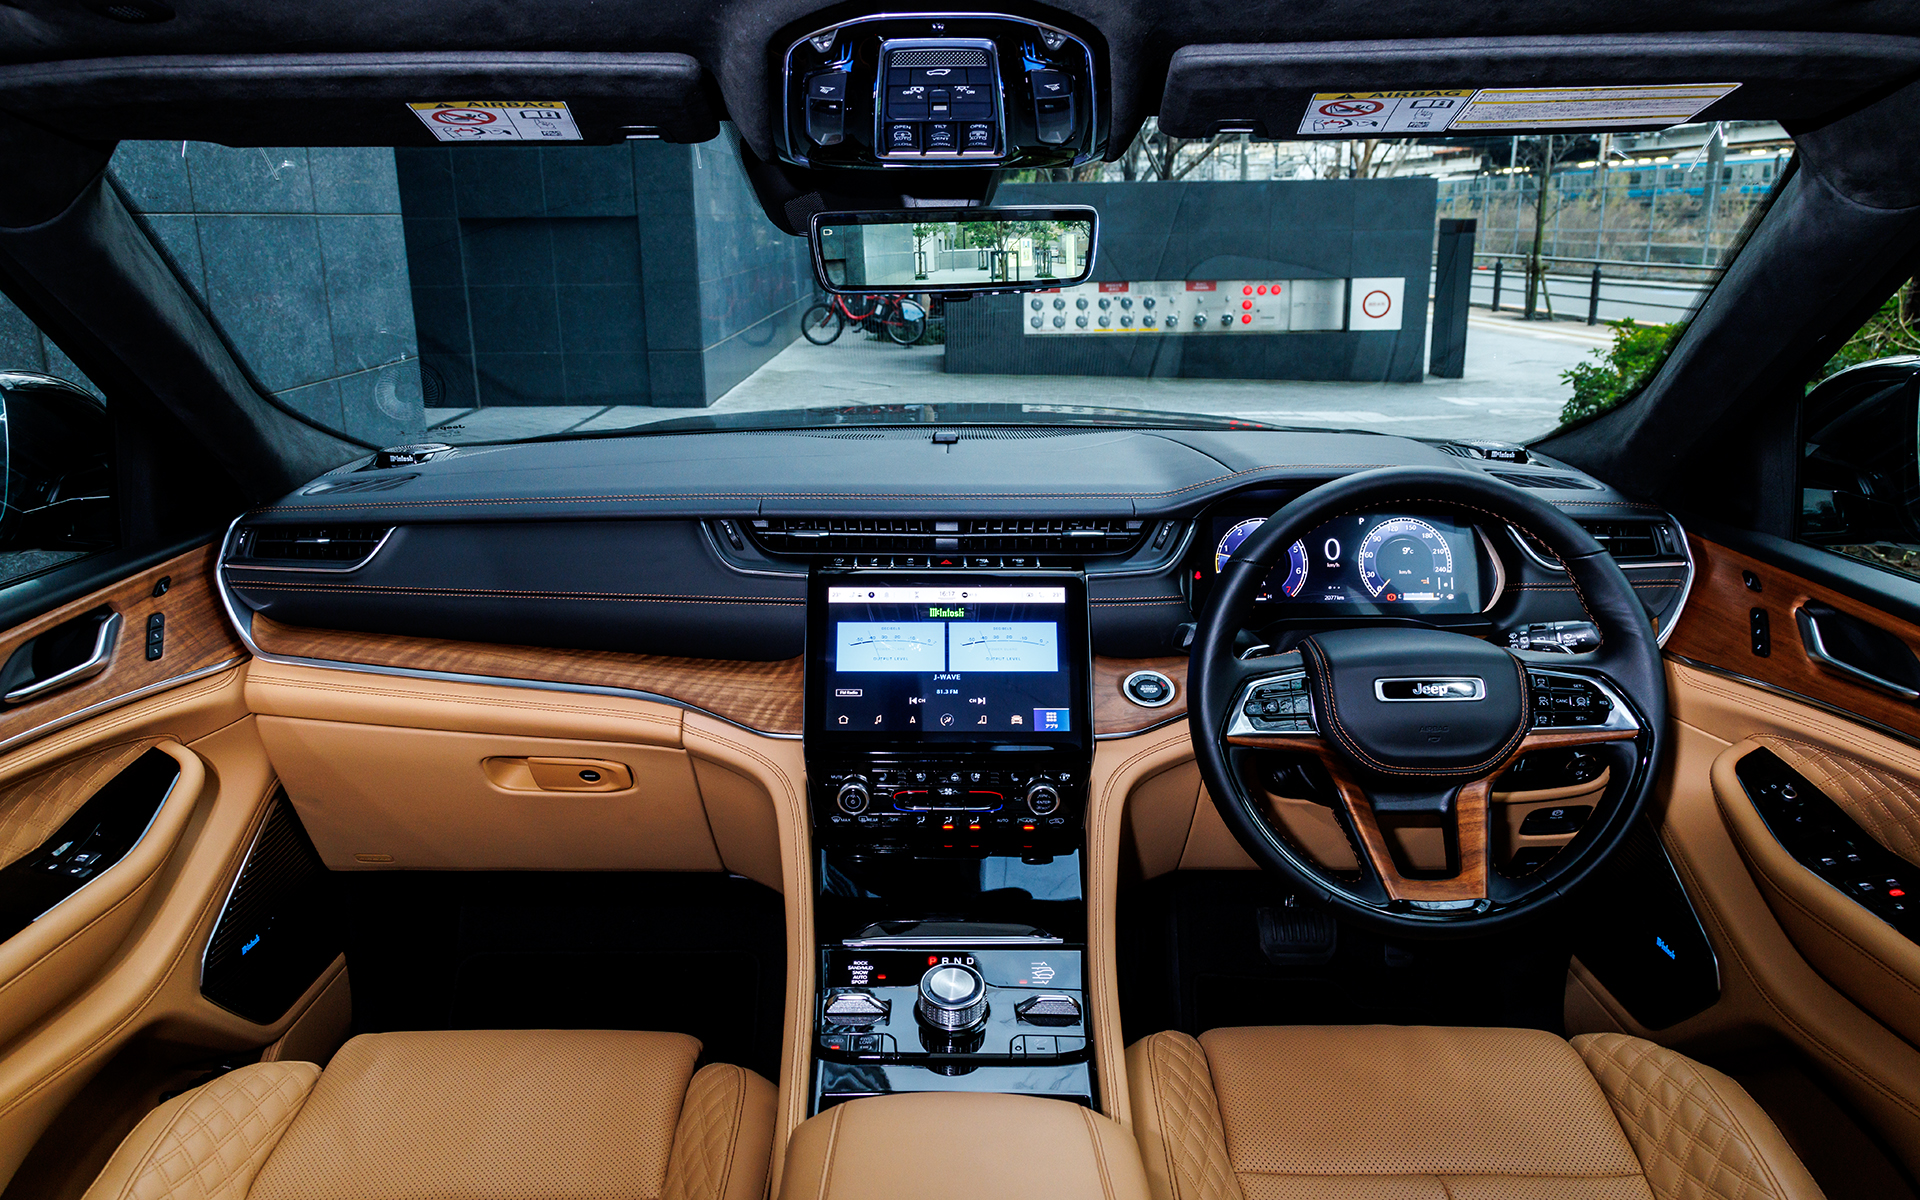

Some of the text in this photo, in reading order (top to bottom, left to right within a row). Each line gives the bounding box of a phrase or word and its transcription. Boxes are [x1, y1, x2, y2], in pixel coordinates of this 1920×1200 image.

[1368, 90, 1462, 98] AIRBAG
[1358, 517, 1365, 525] P
[1324, 538, 1341, 561] 0
[1364, 551, 1374, 559] 60
[1295, 567, 1301, 575] 6
[929, 607, 965, 617] McIntosh
[933, 673, 961, 681] J-WAVE
[1412, 683, 1448, 696] Jeep
[928, 956, 938, 965] P
[966, 957, 974, 965] D
